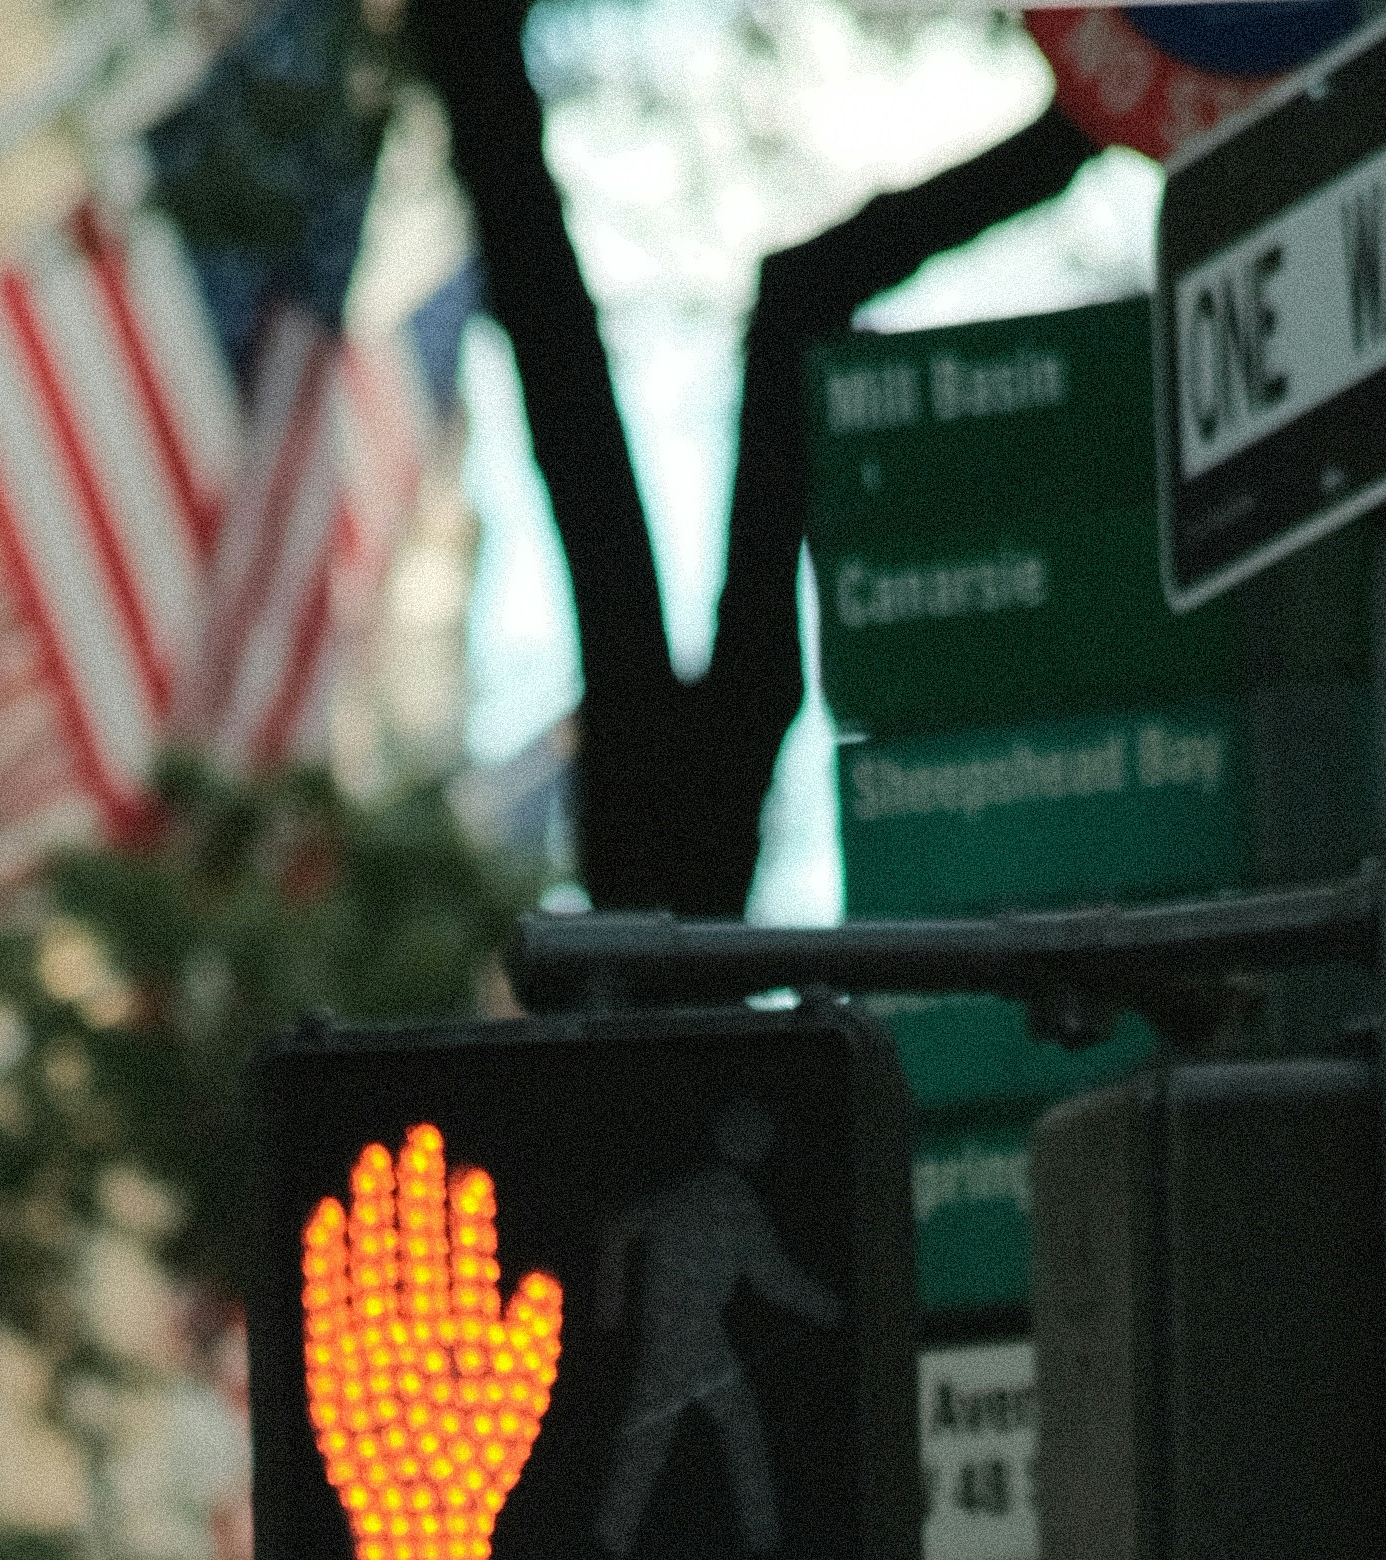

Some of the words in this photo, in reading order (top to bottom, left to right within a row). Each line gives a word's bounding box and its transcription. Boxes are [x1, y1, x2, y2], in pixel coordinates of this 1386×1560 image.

[1186, 244, 1289, 446] ONE
[826, 360, 916, 432] Mill
[932, 352, 1066, 422] Basin
[837, 553, 1046, 628] Canarsie
[852, 736, 1125, 822] Sheepshead
[1137, 726, 1224, 795] Bay
